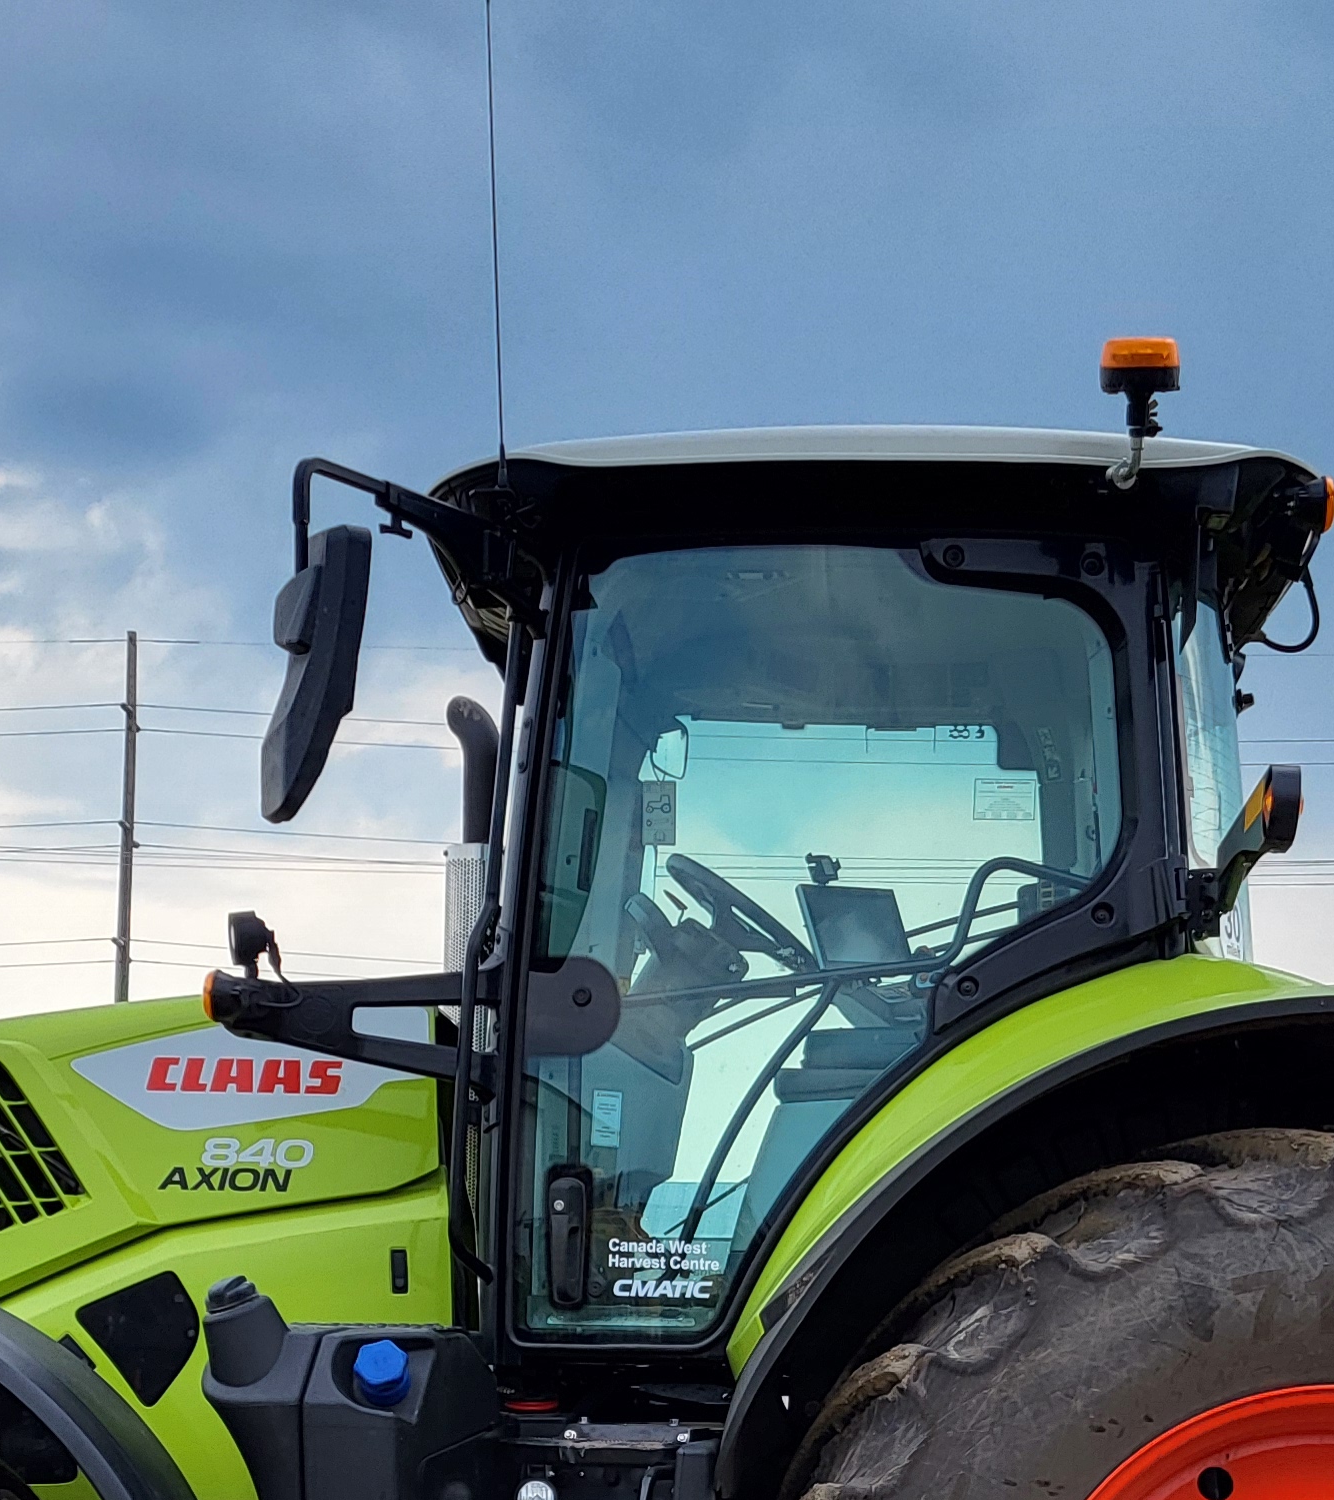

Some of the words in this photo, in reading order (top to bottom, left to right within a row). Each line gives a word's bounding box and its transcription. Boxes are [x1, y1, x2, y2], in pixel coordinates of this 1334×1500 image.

[145, 1056, 344, 1095] CLAAS
[201, 1136, 315, 1169] 840
[157, 1166, 293, 1193] AXION
[608, 1237, 665, 1255] Canada
[669, 1240, 708, 1255] West
[608, 1253, 666, 1270] Harvest
[669, 1255, 720, 1272] Centre
[612, 1279, 714, 1299] CMATIC
